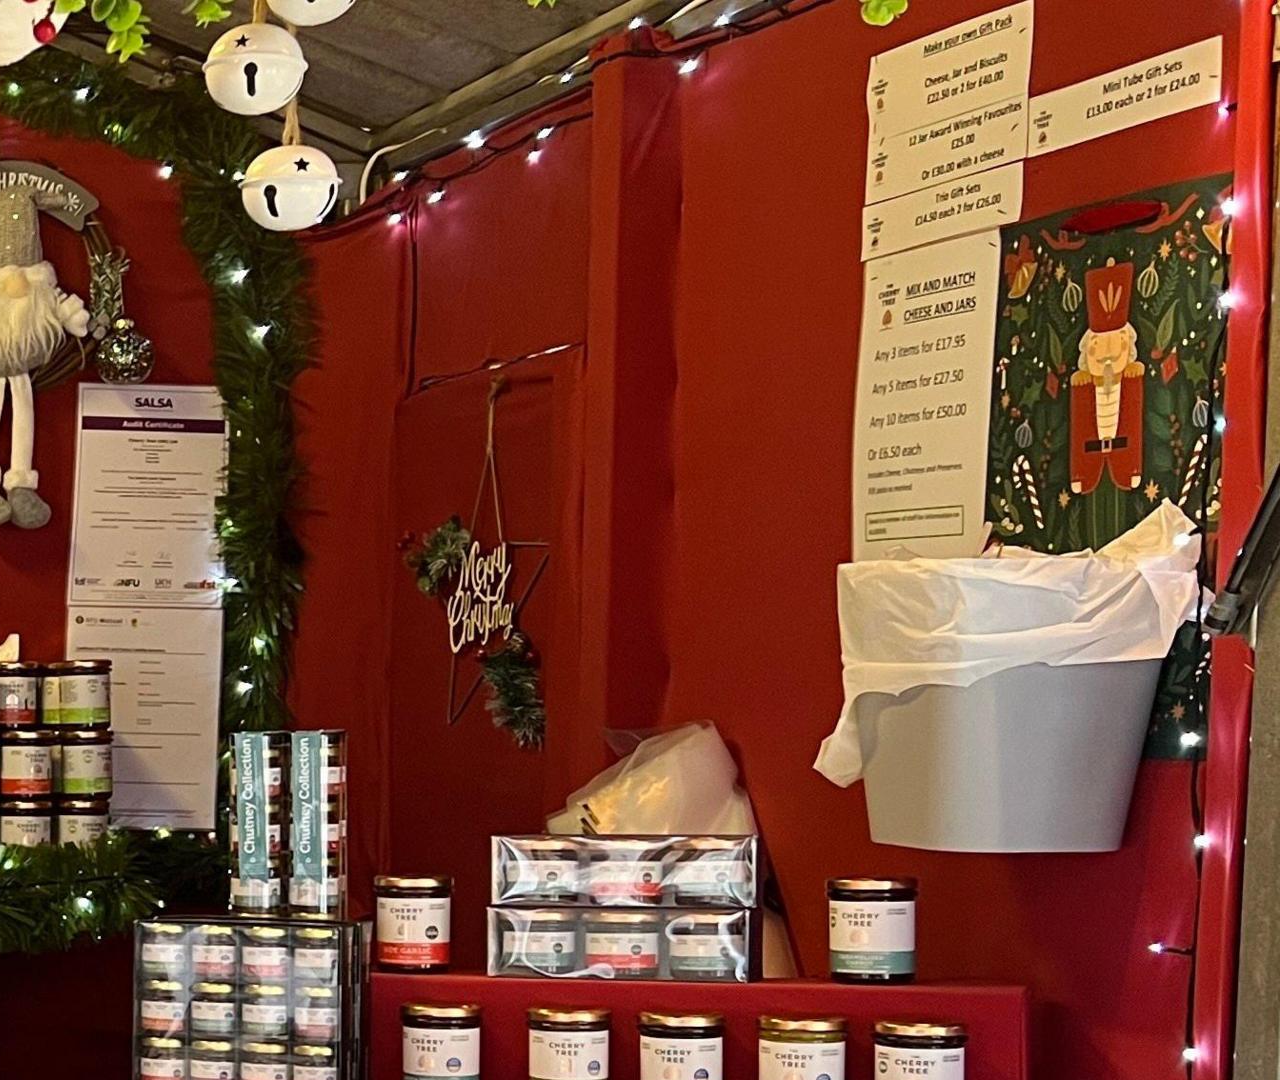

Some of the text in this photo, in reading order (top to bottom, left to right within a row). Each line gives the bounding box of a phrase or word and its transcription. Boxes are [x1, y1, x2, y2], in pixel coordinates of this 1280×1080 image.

[923, 14, 1013, 55] Make your own Gift Pack
[924, 51, 1008, 89] Cheese, Jar and Biscuits
[1103, 59, 1182, 95] Mini Tube Gift Sets
[1086, 73, 1200, 119] £13.00 each or 2 for £24.00
[905, 271, 976, 298] MIX AND MATCH
[903, 297, 976, 323] CHEESE AND JARS
[875, 334, 966, 364] Any 3 items for £17.95
[872, 368, 964, 396] Any 5 items for £27.50
[135, 397, 173, 408] SALSA
[869, 403, 967, 430] Any 10 items for £50.00
[122, 420, 184, 429] Audit Certificate
[867, 443, 922, 461] Or £6.50 each
[455, 541, 512, 601] Merry
[447, 586, 514, 654] Christmas
[242, 738, 256, 854] Chutney Collection
[299, 737, 313, 854] Chutney Collection
[841, 912, 880, 920] CHERRY
